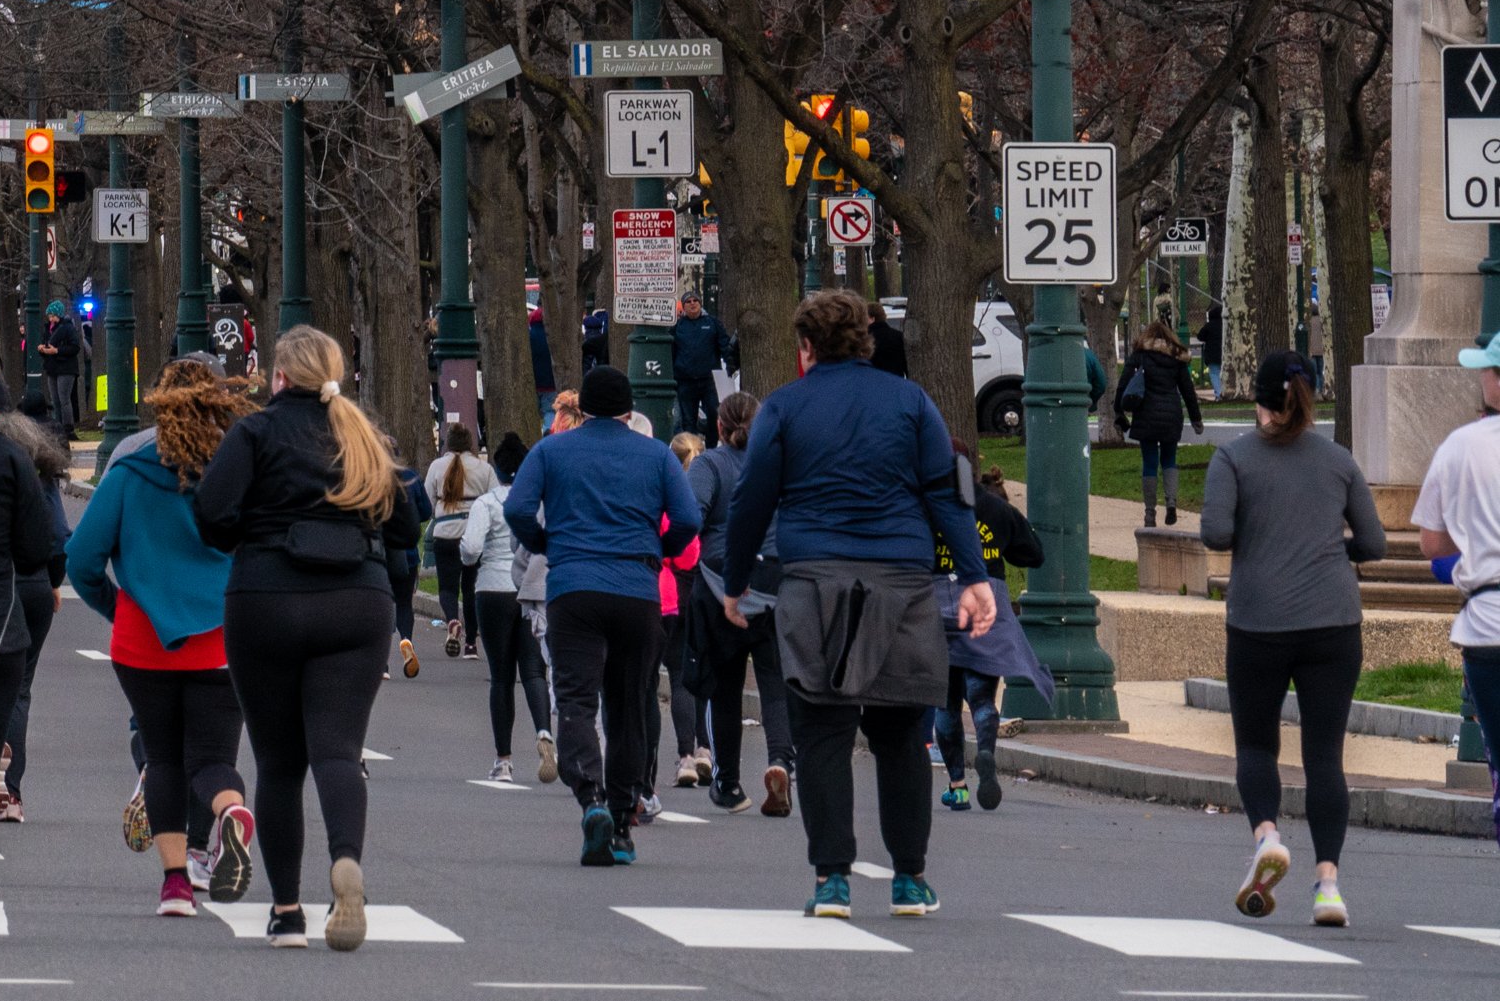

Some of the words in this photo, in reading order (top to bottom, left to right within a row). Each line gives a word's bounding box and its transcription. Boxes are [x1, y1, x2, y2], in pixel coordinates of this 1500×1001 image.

[602, 45, 621, 58] EL
[628, 43, 712, 57] SALVADOR
[603, 61, 647, 75] República
[648, 61, 658, 72] de
[661, 61, 673, 71] El
[675, 60, 713, 71] Salvador
[441, 59, 494, 91] ERITREA
[171, 95, 223, 105] ETHIOPIA
[620, 99, 678, 109] PARKWAY
[618, 111, 681, 121] LOCATION
[25, 121, 64, 130] FIAND
[631, 130, 669, 167] L-1
[1016, 160, 1103, 182] SPEED
[104, 193, 141, 201] PARKWAY
[1025, 187, 1094, 208] LIMIT
[628, 212, 660, 220] SNOW
[110, 213, 135, 237] K-1
[615, 220, 673, 229] EMERGENCY
[628, 229, 661, 237] ROUTE
[1024, 217, 1097, 266] 25
[1165, 244, 1180, 252] BIKE
[1183, 244, 1202, 252] LANE
[619, 303, 673, 311] INFORMATION
